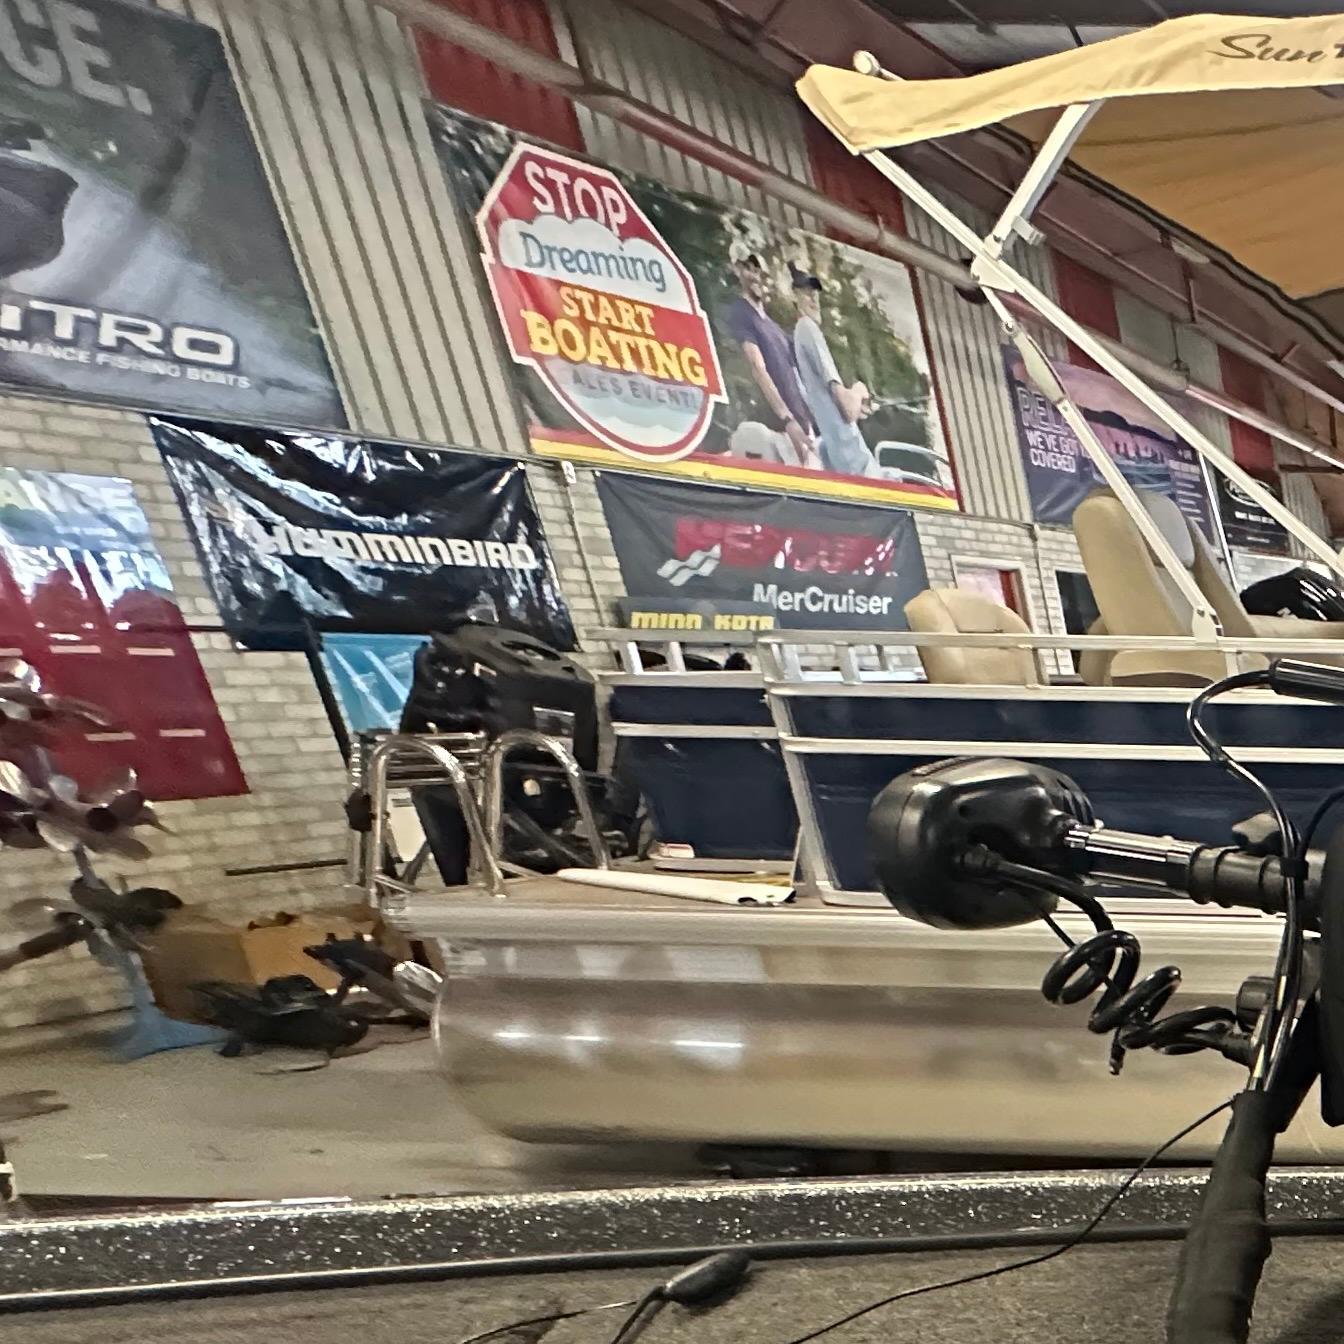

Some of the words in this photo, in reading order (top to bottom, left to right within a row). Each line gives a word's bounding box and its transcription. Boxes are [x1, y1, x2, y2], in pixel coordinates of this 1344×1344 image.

[1207, 33, 1328, 63] Sun
[524, 160, 628, 237] STOP
[518, 231, 667, 293] Dreaming
[559, 284, 655, 336] START
[519, 308, 709, 387] BOATING
[95, 352, 182, 378] FISHING
[185, 367, 251, 390] BOATS
[1029, 447, 1077, 474] COVERED
[753, 583, 893, 615] MerCruiser
